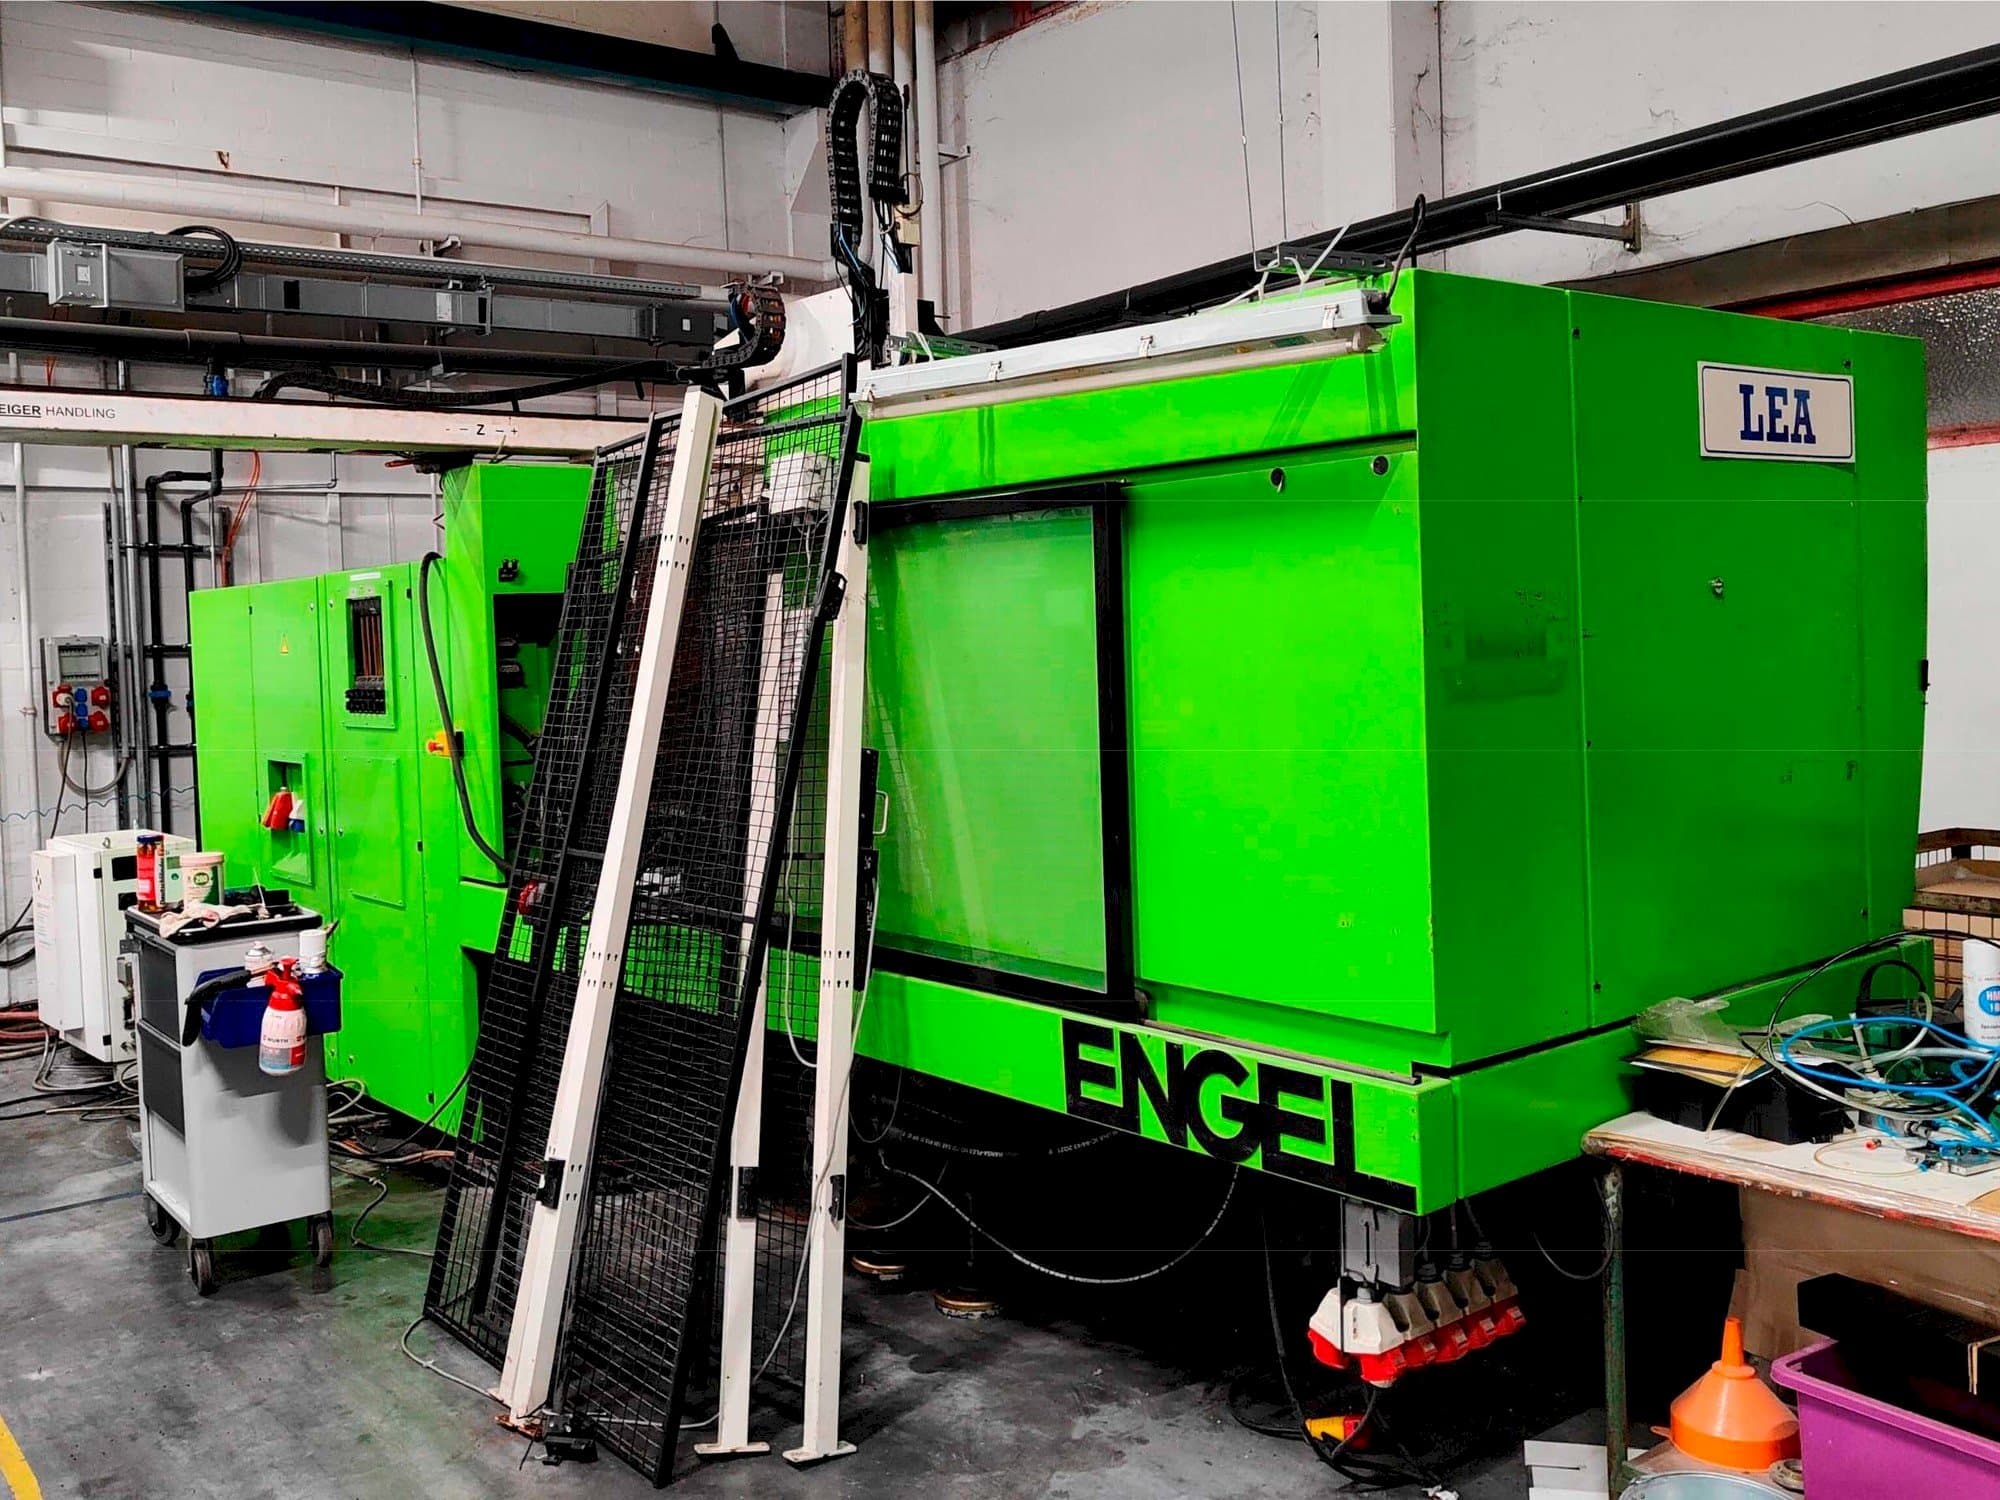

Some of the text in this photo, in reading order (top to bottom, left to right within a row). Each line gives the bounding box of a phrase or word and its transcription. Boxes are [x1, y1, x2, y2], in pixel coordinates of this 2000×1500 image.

[46, 406, 116, 419] HANDLING
[1739, 384, 1816, 444] LEA
[1062, 1017, 1417, 1214] ENGEL
